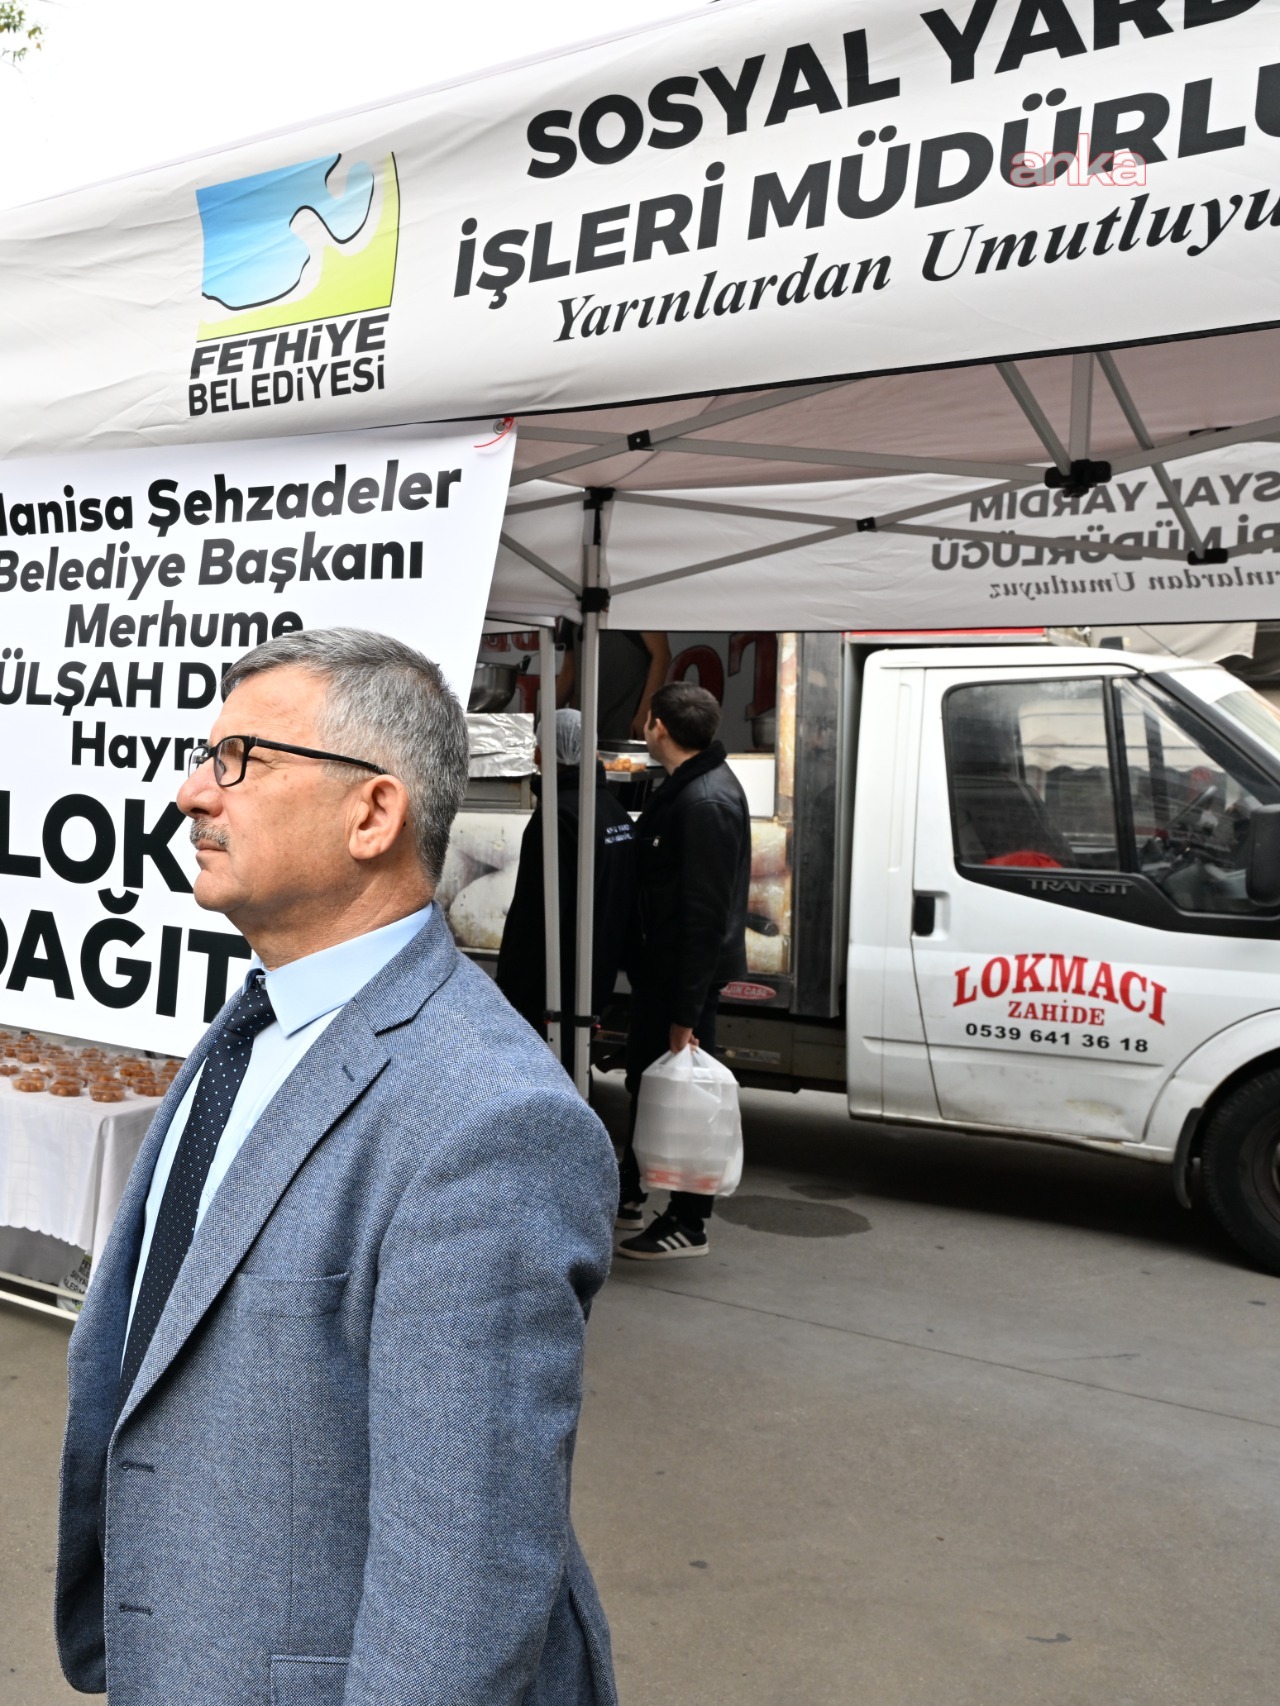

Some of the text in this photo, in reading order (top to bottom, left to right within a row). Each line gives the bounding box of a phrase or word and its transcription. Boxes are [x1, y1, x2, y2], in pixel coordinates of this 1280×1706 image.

[526, 28, 901, 180] SOSYAL
[453, 161, 727, 309] İŞLERİ
[554, 252, 893, 343] Yarınlardan
[147, 459, 462, 537] Şehzadeler
[198, 531, 423, 594] Başkanı
[65, 600, 304, 648] Merhume
[953, 953, 1168, 1026] LOKMACI
[1008, 999, 1105, 1026] ZAHİDE
[965, 1022, 1148, 1052] 0539 641 36 18
